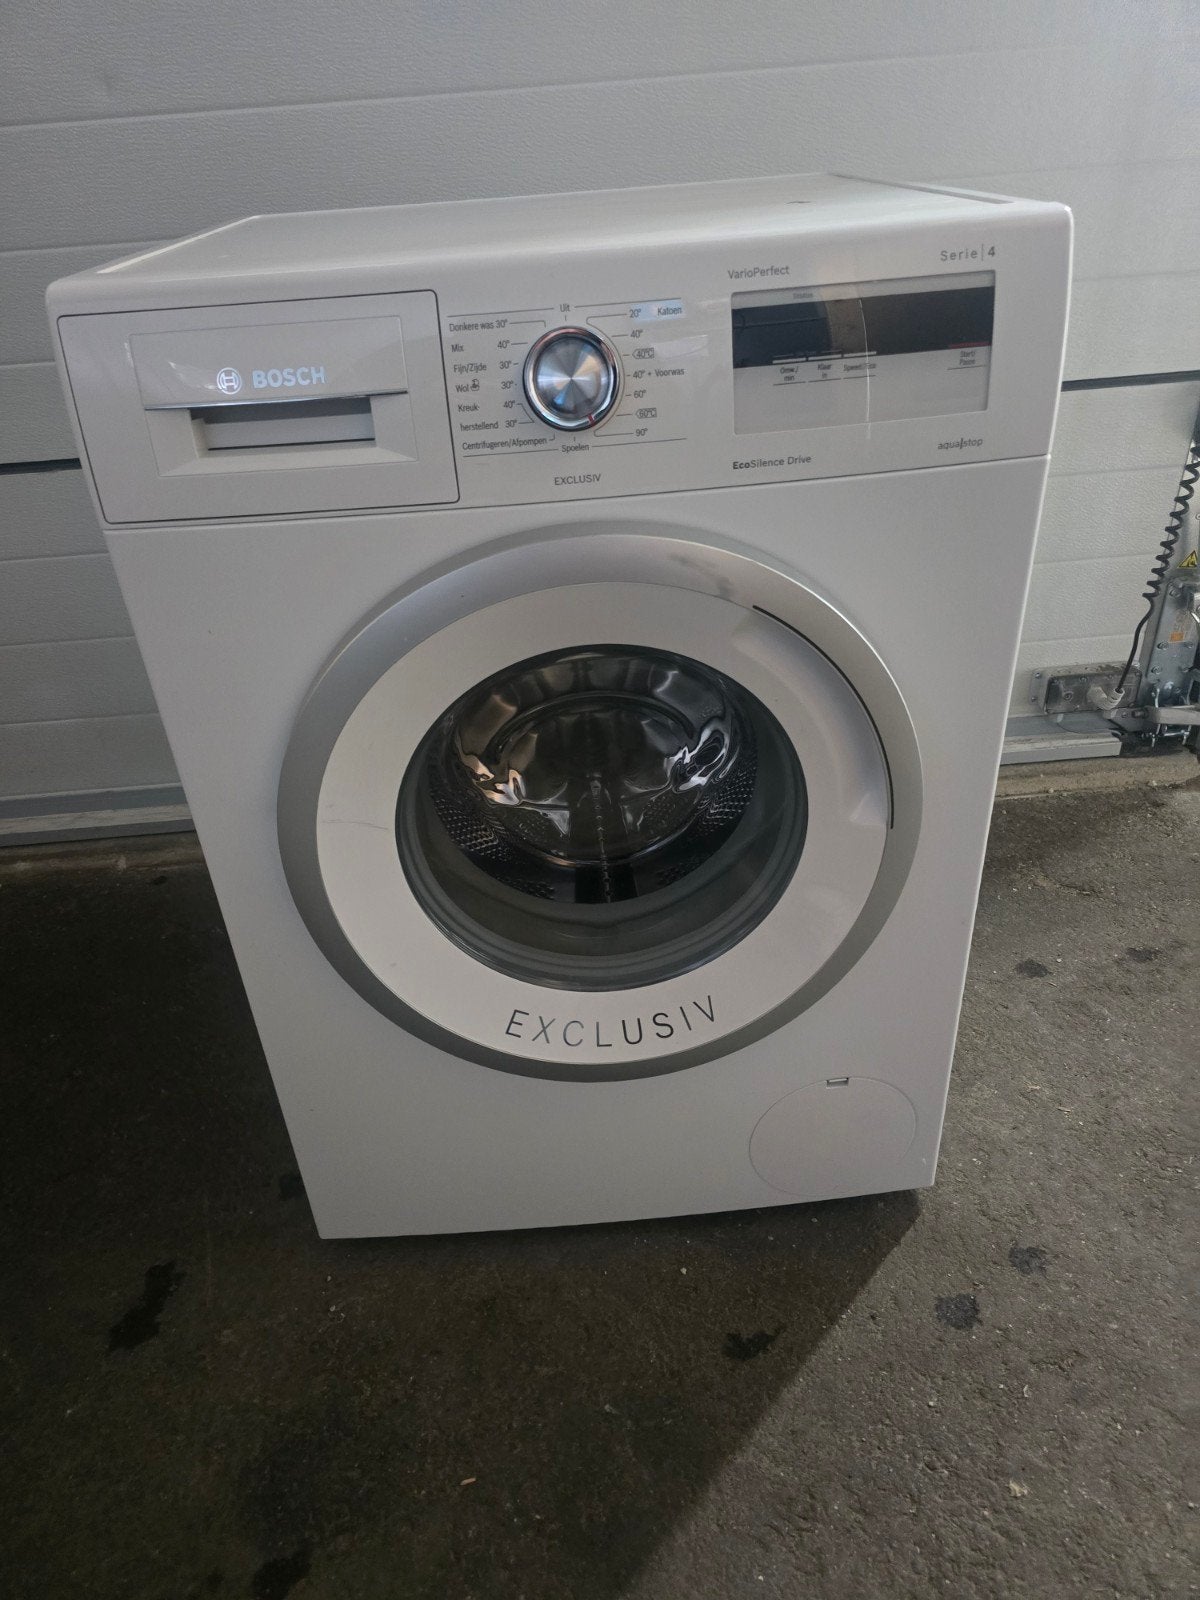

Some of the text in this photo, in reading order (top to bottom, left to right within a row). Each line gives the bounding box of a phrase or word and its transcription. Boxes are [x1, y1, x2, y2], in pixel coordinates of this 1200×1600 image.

[940, 248, 978, 261] Serie
[727, 264, 790, 280] VarioPerfect
[560, 303, 571, 313] Uit
[657, 306, 682, 316] Katoen
[449, 319, 508, 333] Donkere was 30°
[451, 344, 465, 353] Mix
[453, 362, 488, 374] Fijn/Zijde
[654, 367, 686, 378] Voorwas
[251, 364, 326, 390] BOSCH
[455, 383, 470, 393] Wol
[460, 420, 499, 432] herstellend
[561, 443, 590, 454] Spoelen
[732, 455, 812, 470] EcoSilence Drive
[554, 473, 602, 486] EXCLUSIV
[505, 994, 715, 1048] EXCLUSIV
